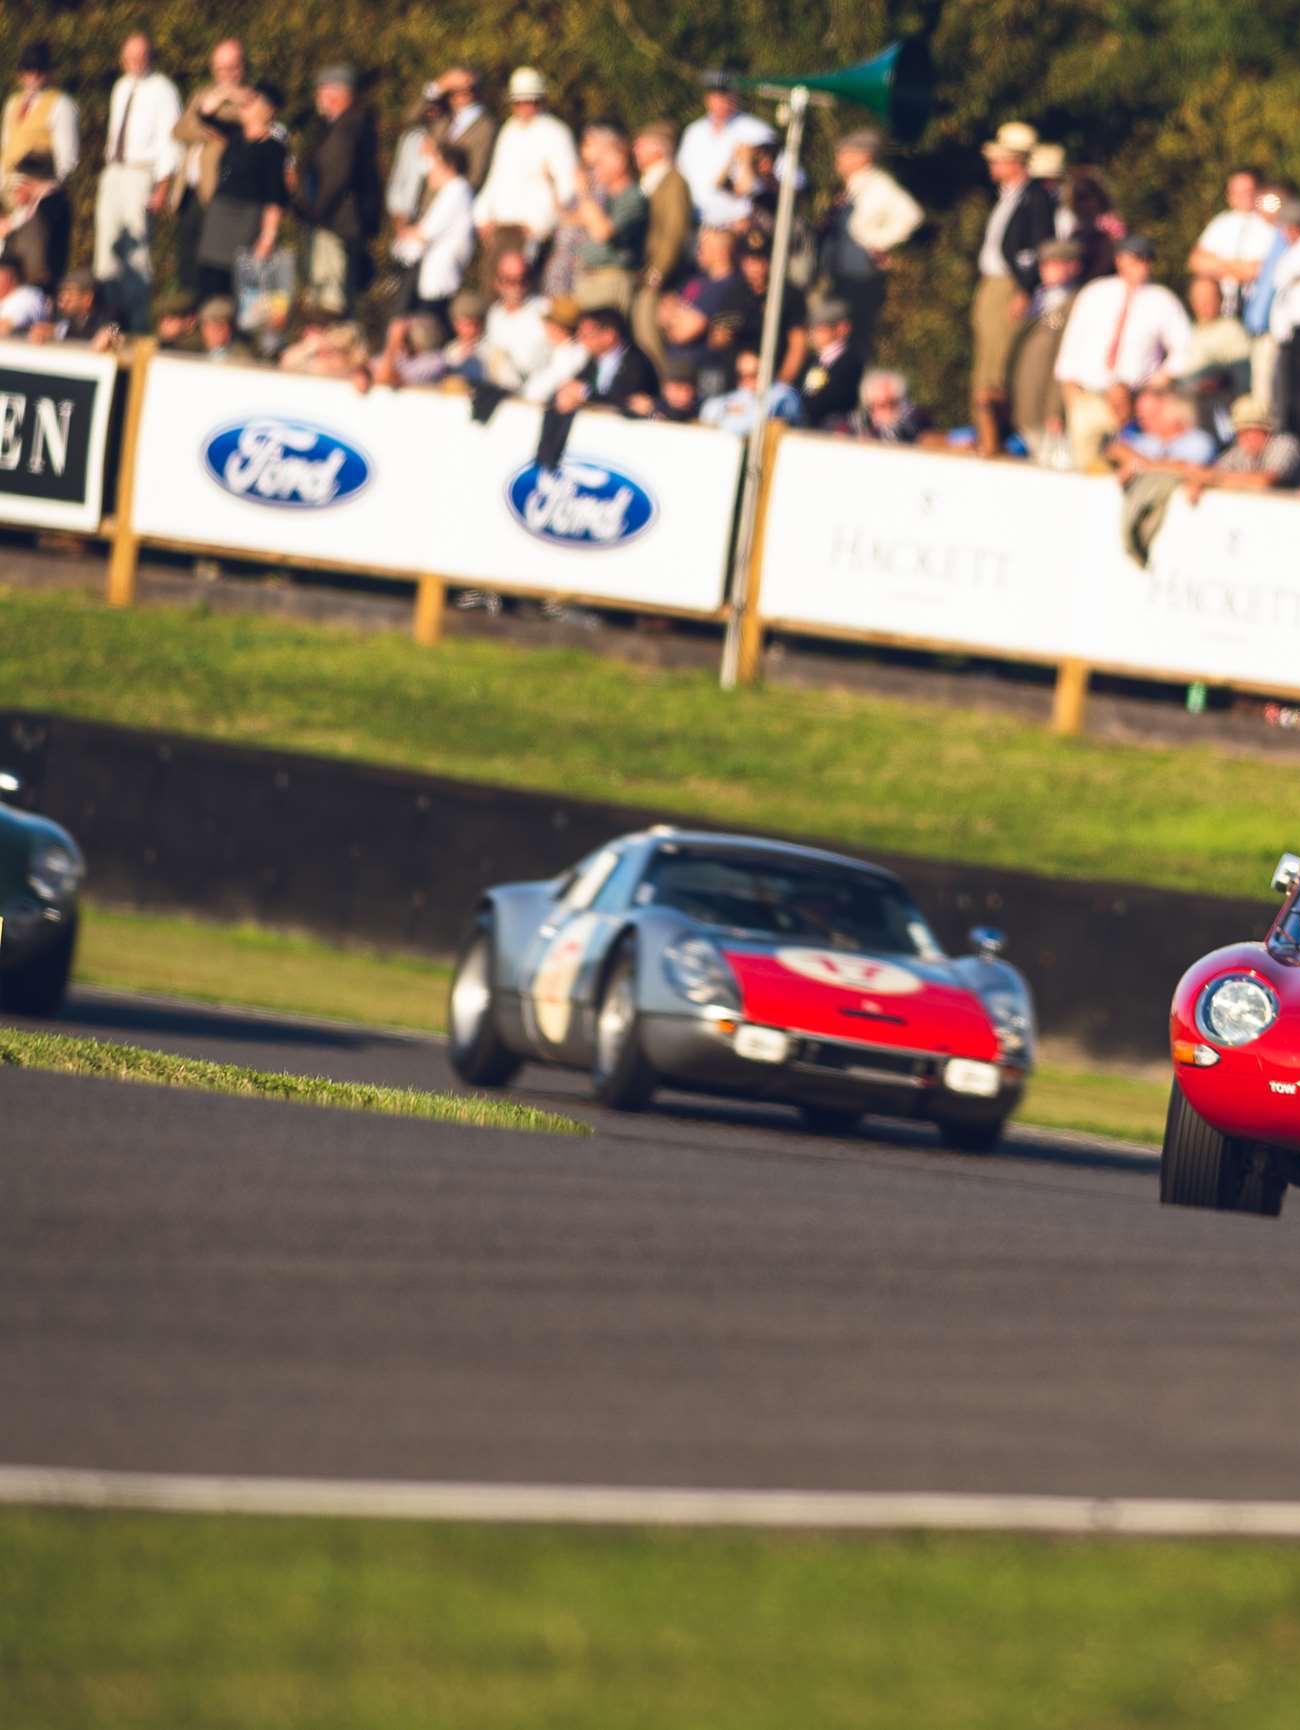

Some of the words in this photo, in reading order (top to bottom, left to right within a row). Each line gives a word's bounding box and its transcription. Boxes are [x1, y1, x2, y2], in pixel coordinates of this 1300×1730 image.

[223, 423, 347, 504] Ford
[524, 463, 634, 539] Ford
[1269, 1080, 1296, 1095] TOW
